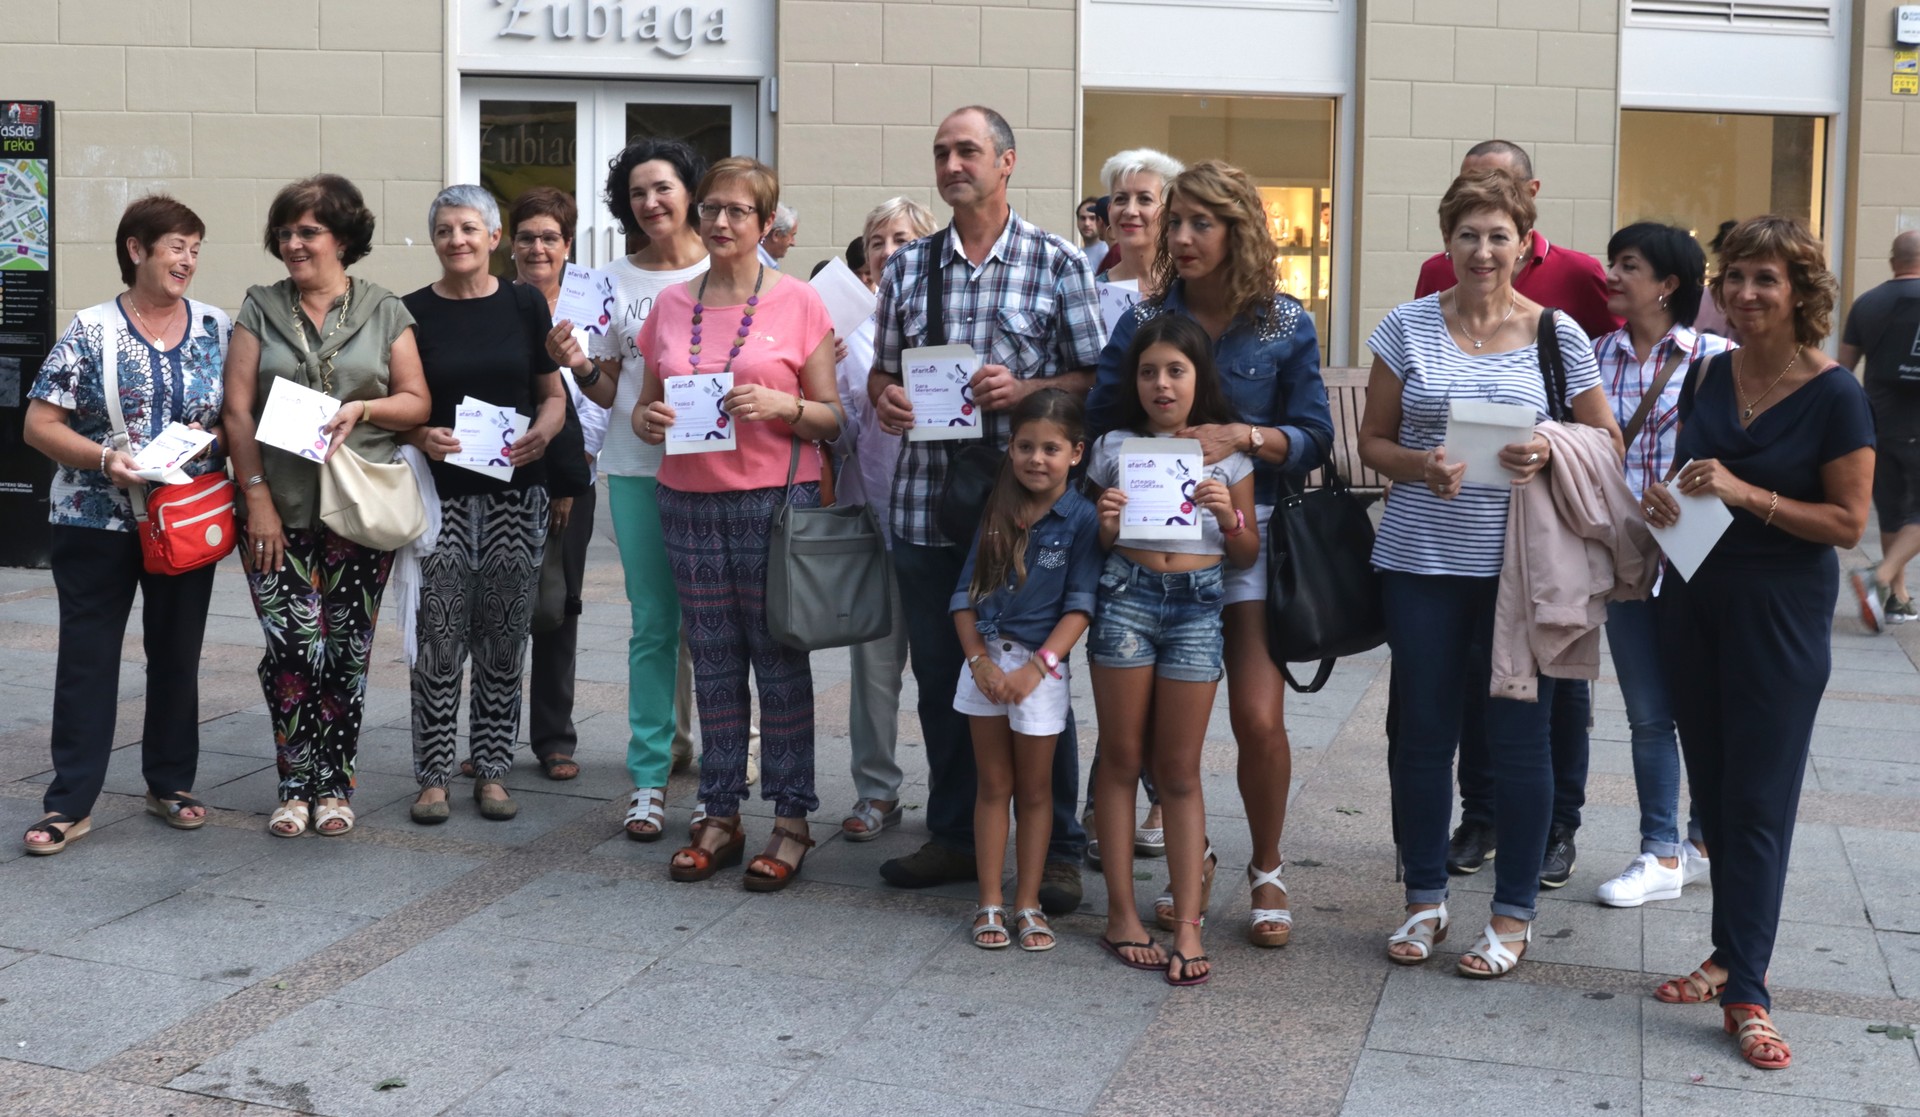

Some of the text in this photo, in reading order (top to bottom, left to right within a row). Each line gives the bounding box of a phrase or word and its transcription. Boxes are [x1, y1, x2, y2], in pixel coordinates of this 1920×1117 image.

[492, 0, 731, 57] Zubiaga
[0, 124, 34, 137] asate
[4, 136, 35, 152] irekia
[624, 297, 653, 327] NO
